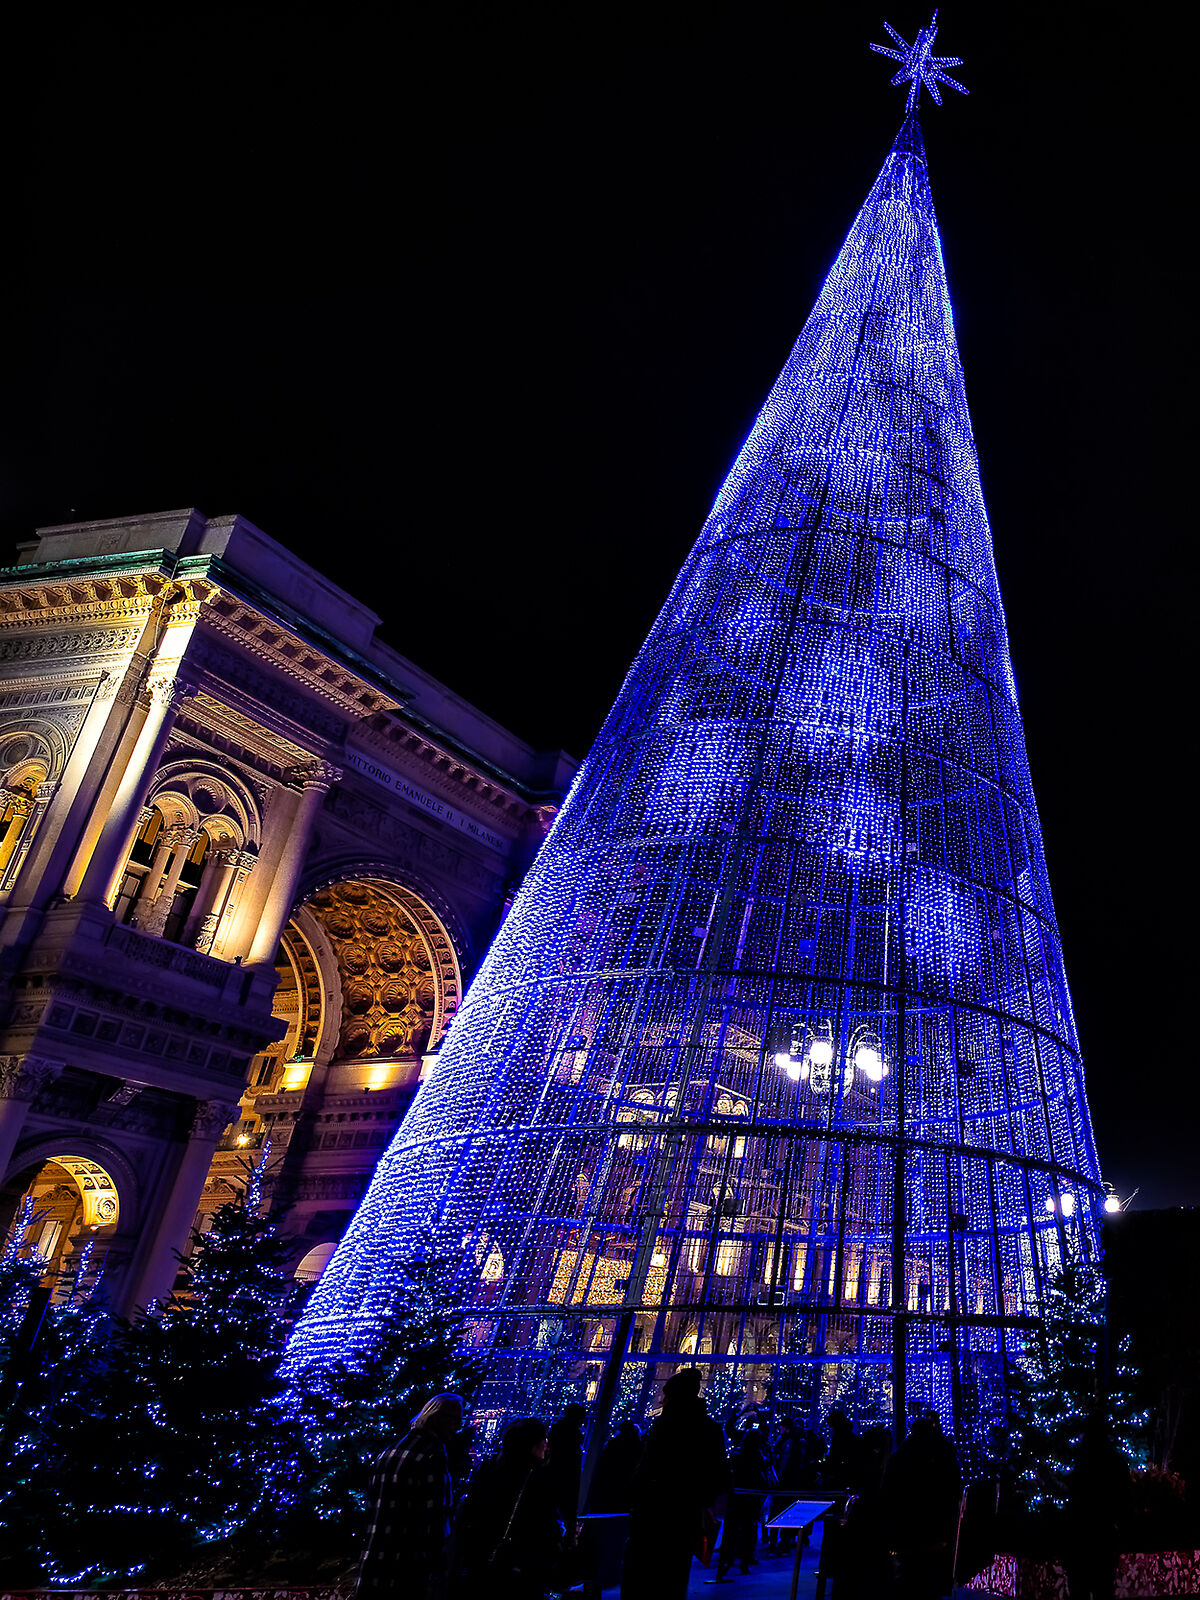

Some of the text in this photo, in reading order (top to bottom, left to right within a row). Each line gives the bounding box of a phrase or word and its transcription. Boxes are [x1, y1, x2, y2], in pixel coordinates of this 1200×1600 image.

[348, 754, 391, 784] VITTORIO
[394, 780, 444, 815] EMANUELE
[467, 822, 504, 849] MILANESI
